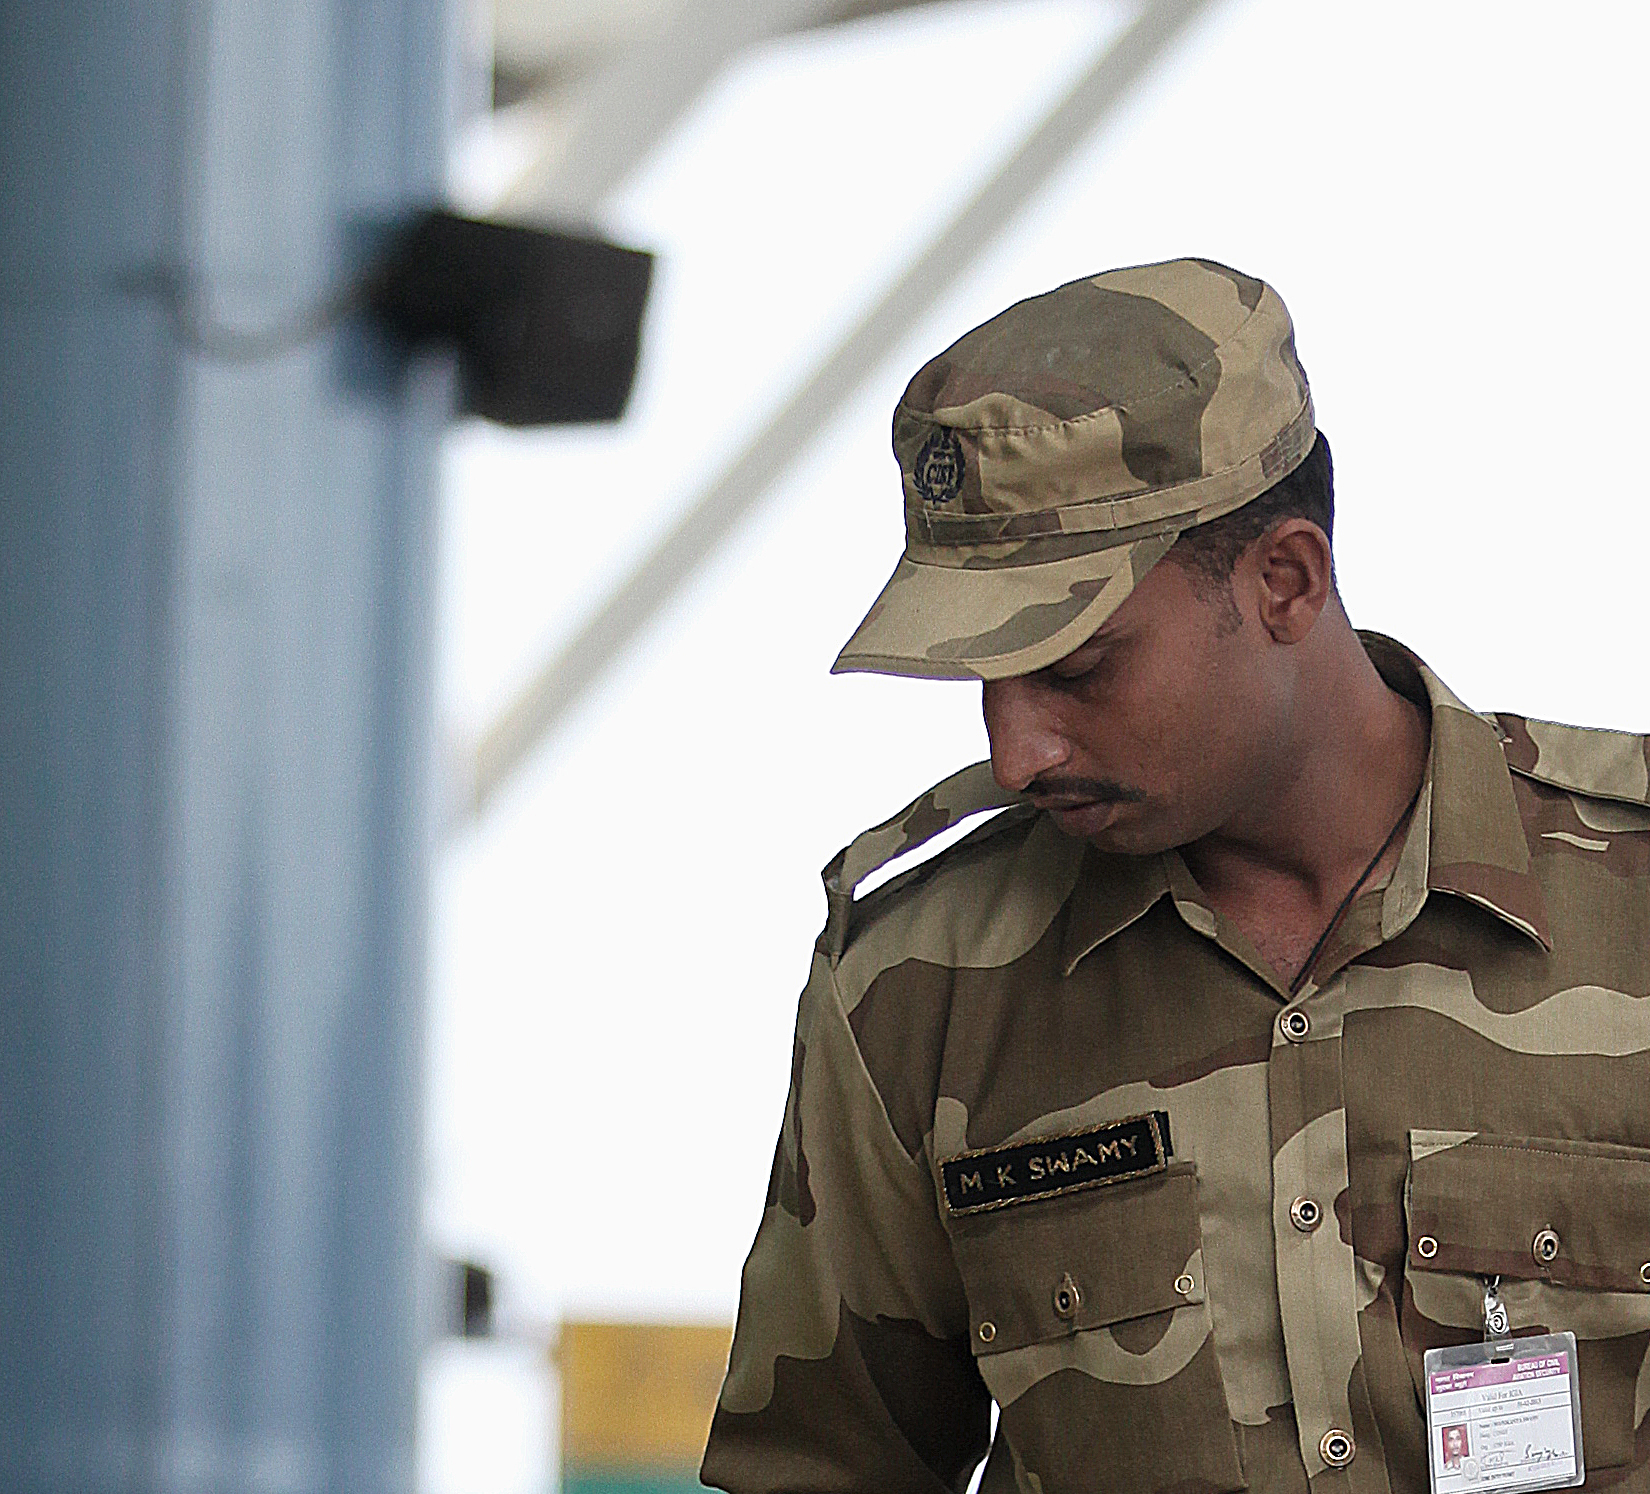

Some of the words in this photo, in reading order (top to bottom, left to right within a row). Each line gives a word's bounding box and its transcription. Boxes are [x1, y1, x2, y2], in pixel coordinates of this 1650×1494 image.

[960, 1171, 983, 1194] M
[997, 1164, 1017, 1188] K
[1028, 1135, 1138, 1180] SWAMY
